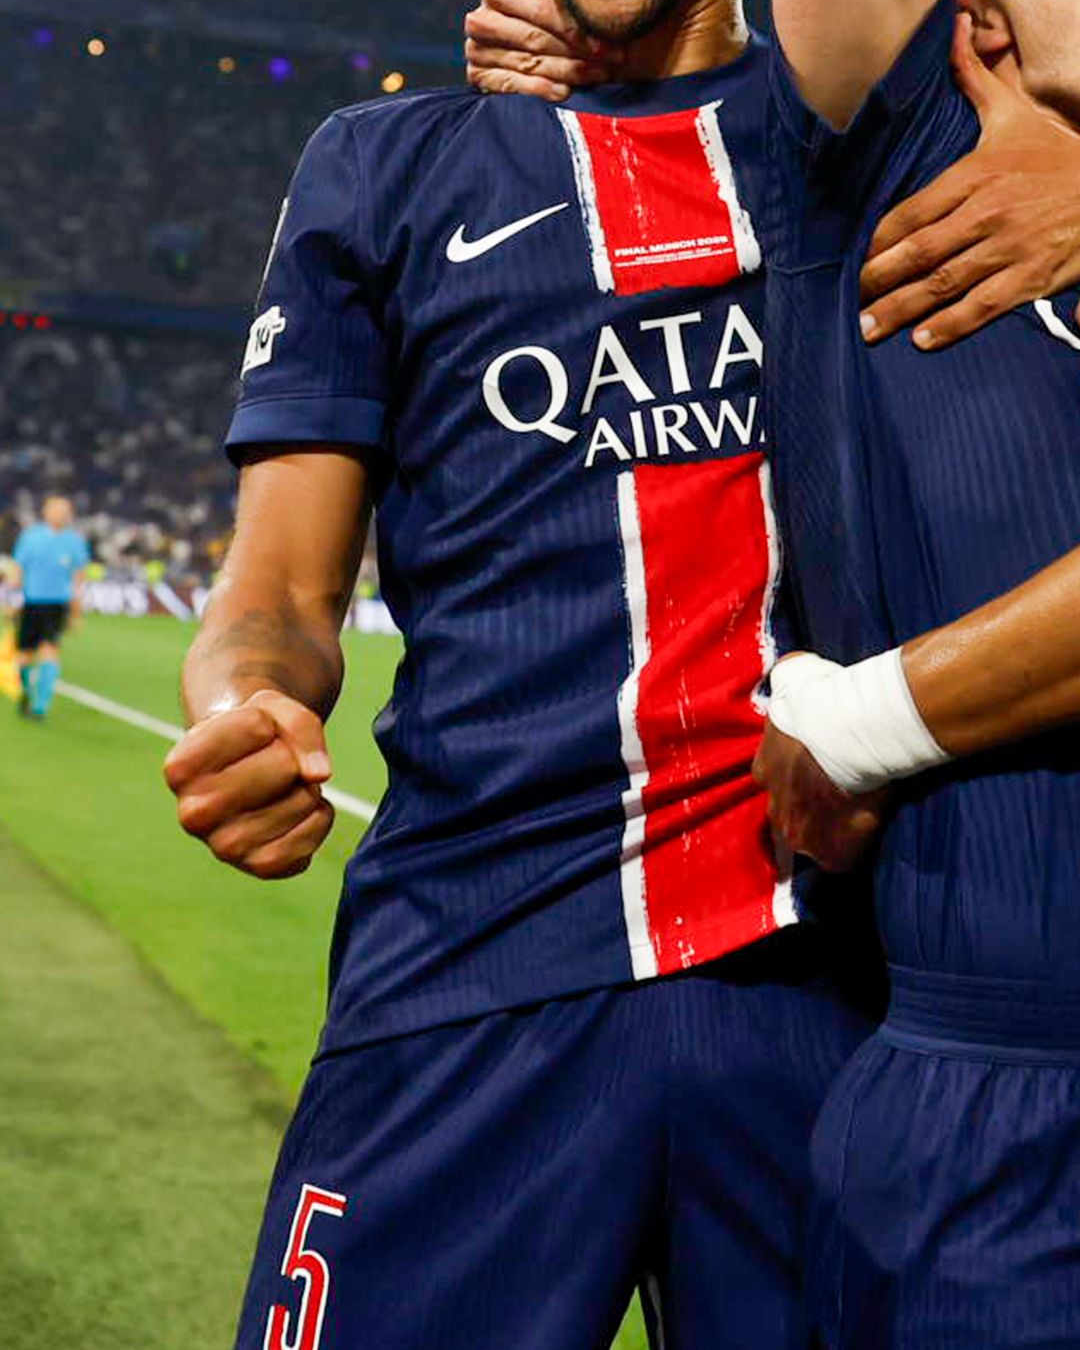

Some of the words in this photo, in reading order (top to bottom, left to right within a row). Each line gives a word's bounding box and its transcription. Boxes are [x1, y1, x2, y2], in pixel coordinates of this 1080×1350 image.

[614, 246, 650, 257] FINAL
[650, 239, 697, 252] MUNICH
[697, 236, 729, 246] 2025
[584, 397, 765, 468] AIRW
[263, 1183, 347, 1350] 5
